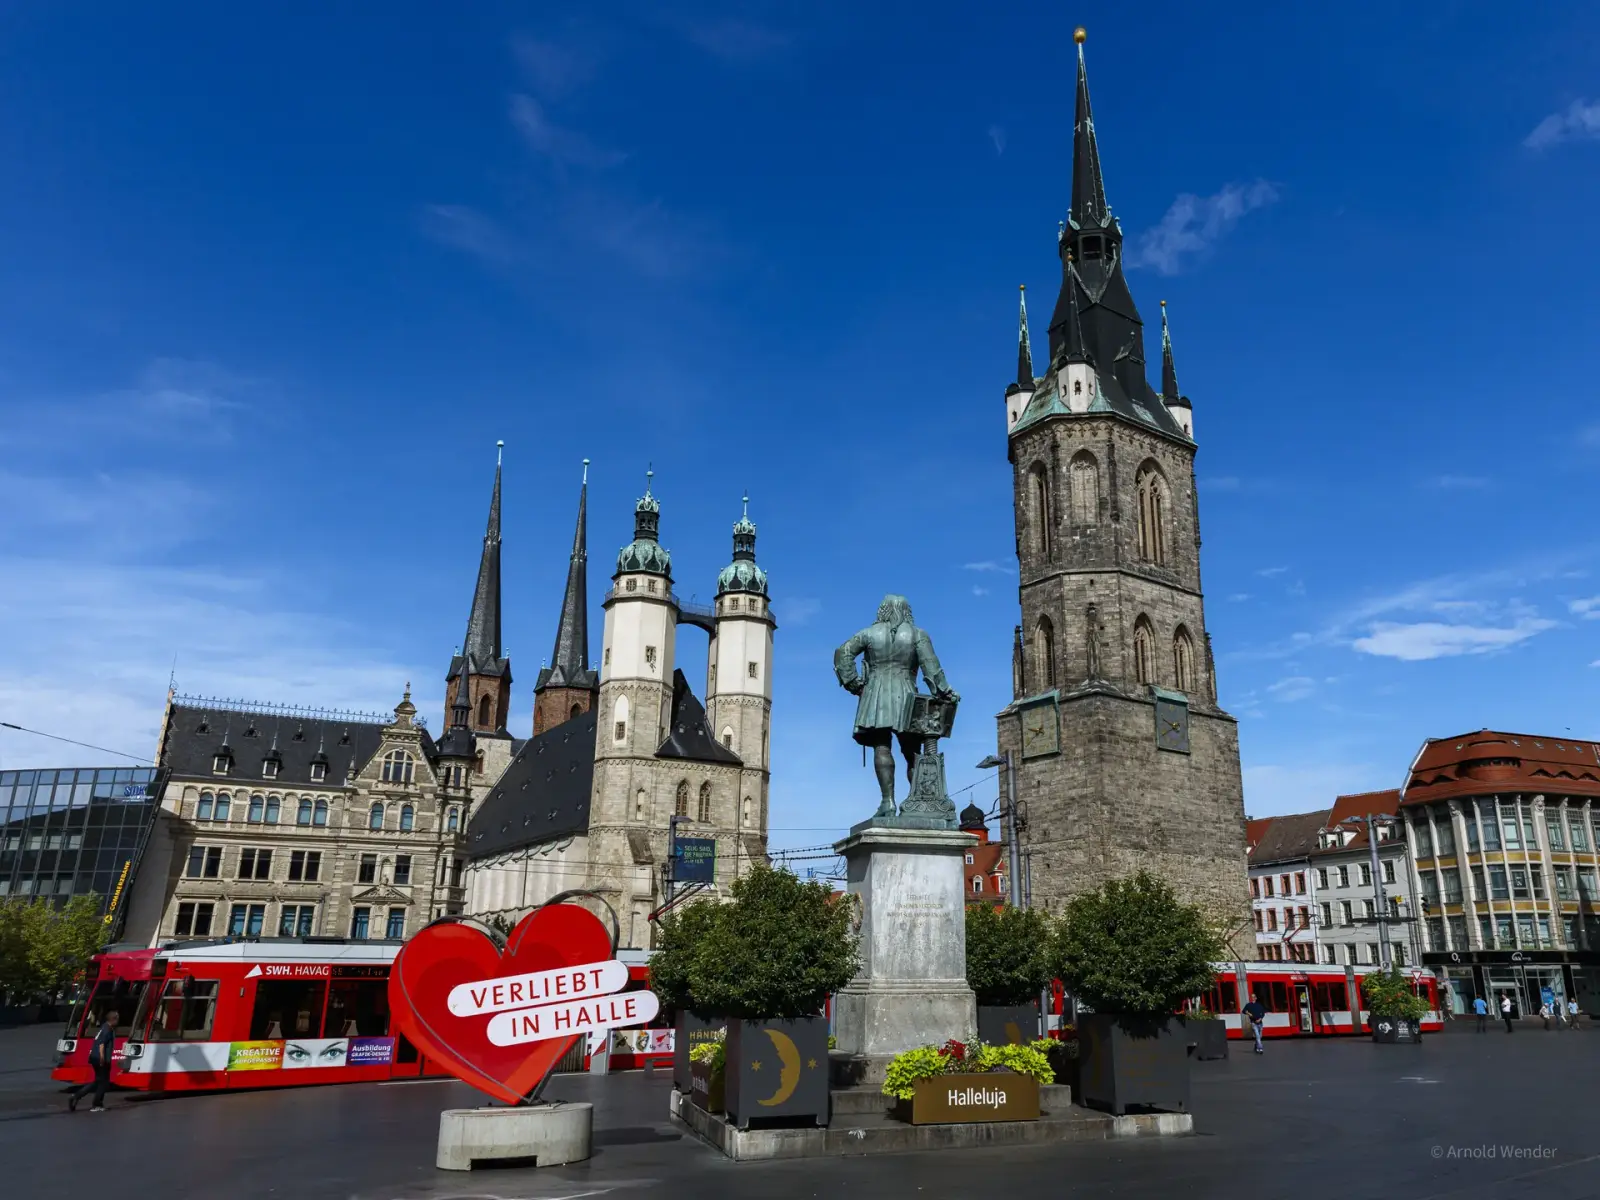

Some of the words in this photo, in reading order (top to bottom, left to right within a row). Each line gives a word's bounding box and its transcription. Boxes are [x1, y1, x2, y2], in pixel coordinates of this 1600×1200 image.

[109, 859, 131, 911] COMMERZBANK
[266, 965, 292, 976] SWH.
[294, 965, 330, 977] HAVAG
[470, 969, 604, 1008] VERLIEBT
[512, 1014, 540, 1037] IN
[554, 998, 637, 1030] HALLE
[236, 1048, 281, 1057] KREATIVE
[948, 1087, 1007, 1109] Halleluja
